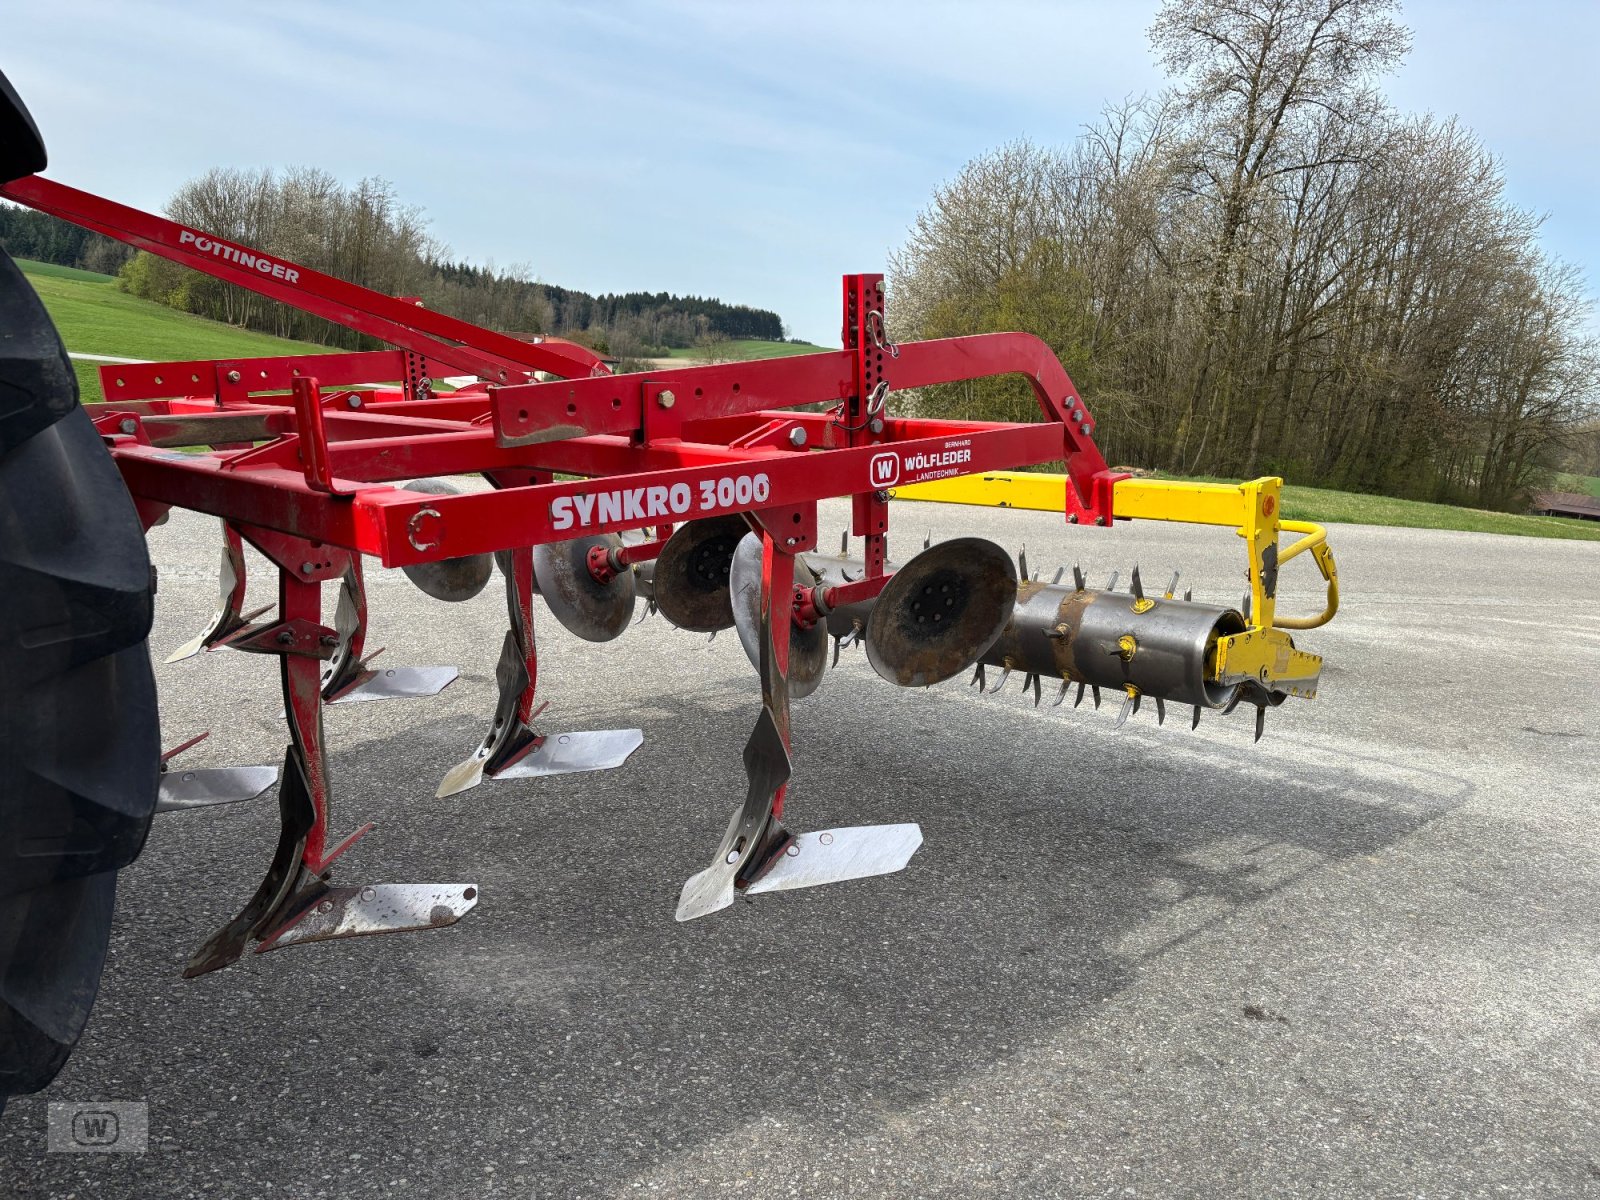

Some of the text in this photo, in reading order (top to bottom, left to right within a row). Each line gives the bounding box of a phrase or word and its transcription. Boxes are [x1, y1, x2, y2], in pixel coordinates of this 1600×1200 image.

[944, 439, 971, 450] BERNHARD
[877, 459, 893, 480] W
[904, 449, 971, 471] WÖLFLEDER
[916, 467, 960, 481] LANDTECHNIK
[551, 473, 770, 530] SYNKRO 3000
